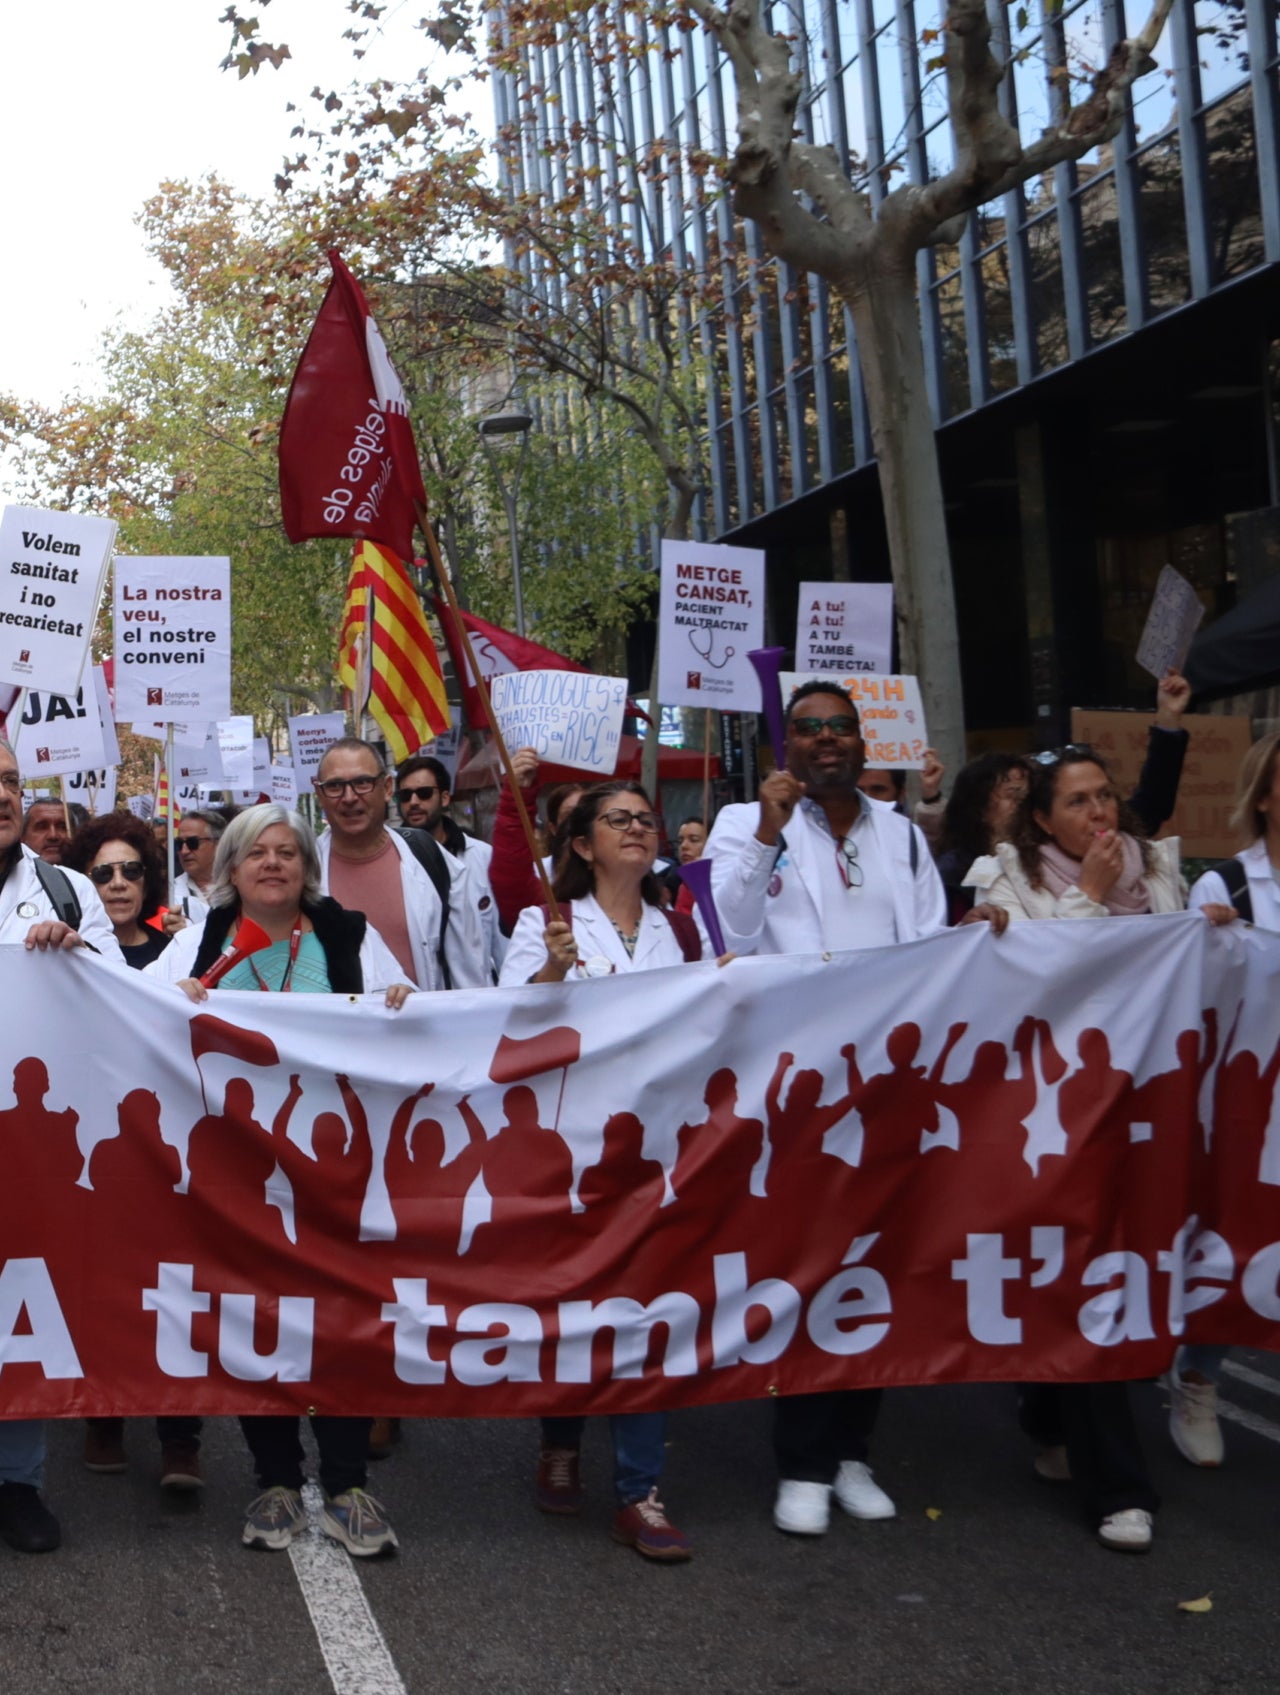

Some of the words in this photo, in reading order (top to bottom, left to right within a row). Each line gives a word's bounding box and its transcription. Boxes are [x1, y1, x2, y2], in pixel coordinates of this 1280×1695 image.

[22, 531, 81, 556] Volem
[10, 562, 79, 584] sanitat
[677, 564, 742, 584] METGE
[20, 586, 28, 603] i
[31, 593, 56, 608] no
[123, 585, 147, 600] La
[155, 586, 222, 600] nostra
[676, 583, 752, 608] CANSAT,
[675, 602, 723, 615] PACIENT
[811, 600, 821, 611] A
[826, 601, 845, 611] tu!
[122, 610, 166, 625] veu,
[675, 616, 748, 631] MALTRACTAT
[810, 615, 820, 625] A
[825, 616, 845, 626] tu!
[123, 627, 141, 642] el
[150, 628, 216, 642] nostre
[809, 631, 818, 640] A
[823, 631, 840, 640] TU
[123, 648, 205, 663] conveni
[809, 643, 854, 655] TAMBÉ
[808, 659, 875, 671] T'AFECTA!
[844, 677, 880, 701] 24
[884, 679, 905, 701] H
[21, 686, 87, 725] JA!
[297, 728, 326, 737] Menys
[562, 710, 610, 765] RISC
[179, 786, 205, 800] JA!
[142, 1262, 315, 1383] tu
[380, 1231, 893, 1386] també
